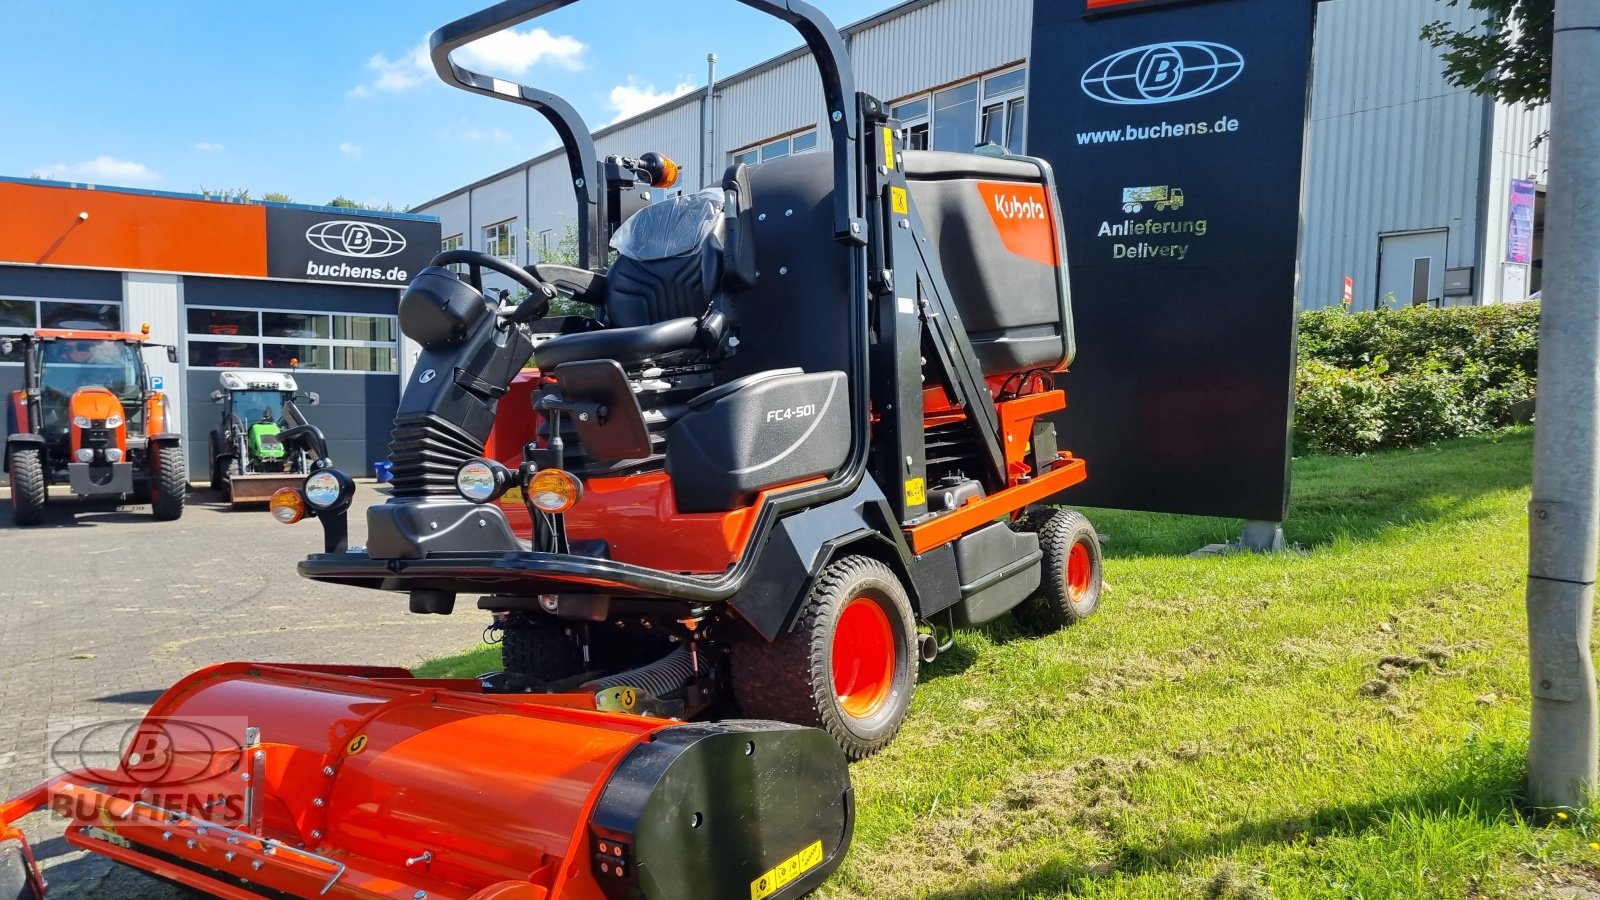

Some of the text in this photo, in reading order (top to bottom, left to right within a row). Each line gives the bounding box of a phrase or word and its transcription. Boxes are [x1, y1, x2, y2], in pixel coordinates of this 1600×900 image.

[1076, 116, 1239, 145] www.buchens.de
[994, 194, 1045, 219] Kubota
[1097, 219, 1208, 237] Anlieferung
[1113, 242, 1190, 260] Delivery
[306, 260, 408, 281] buchens.de
[151, 377, 162, 389] P
[766, 403, 816, 423] FC4-501
